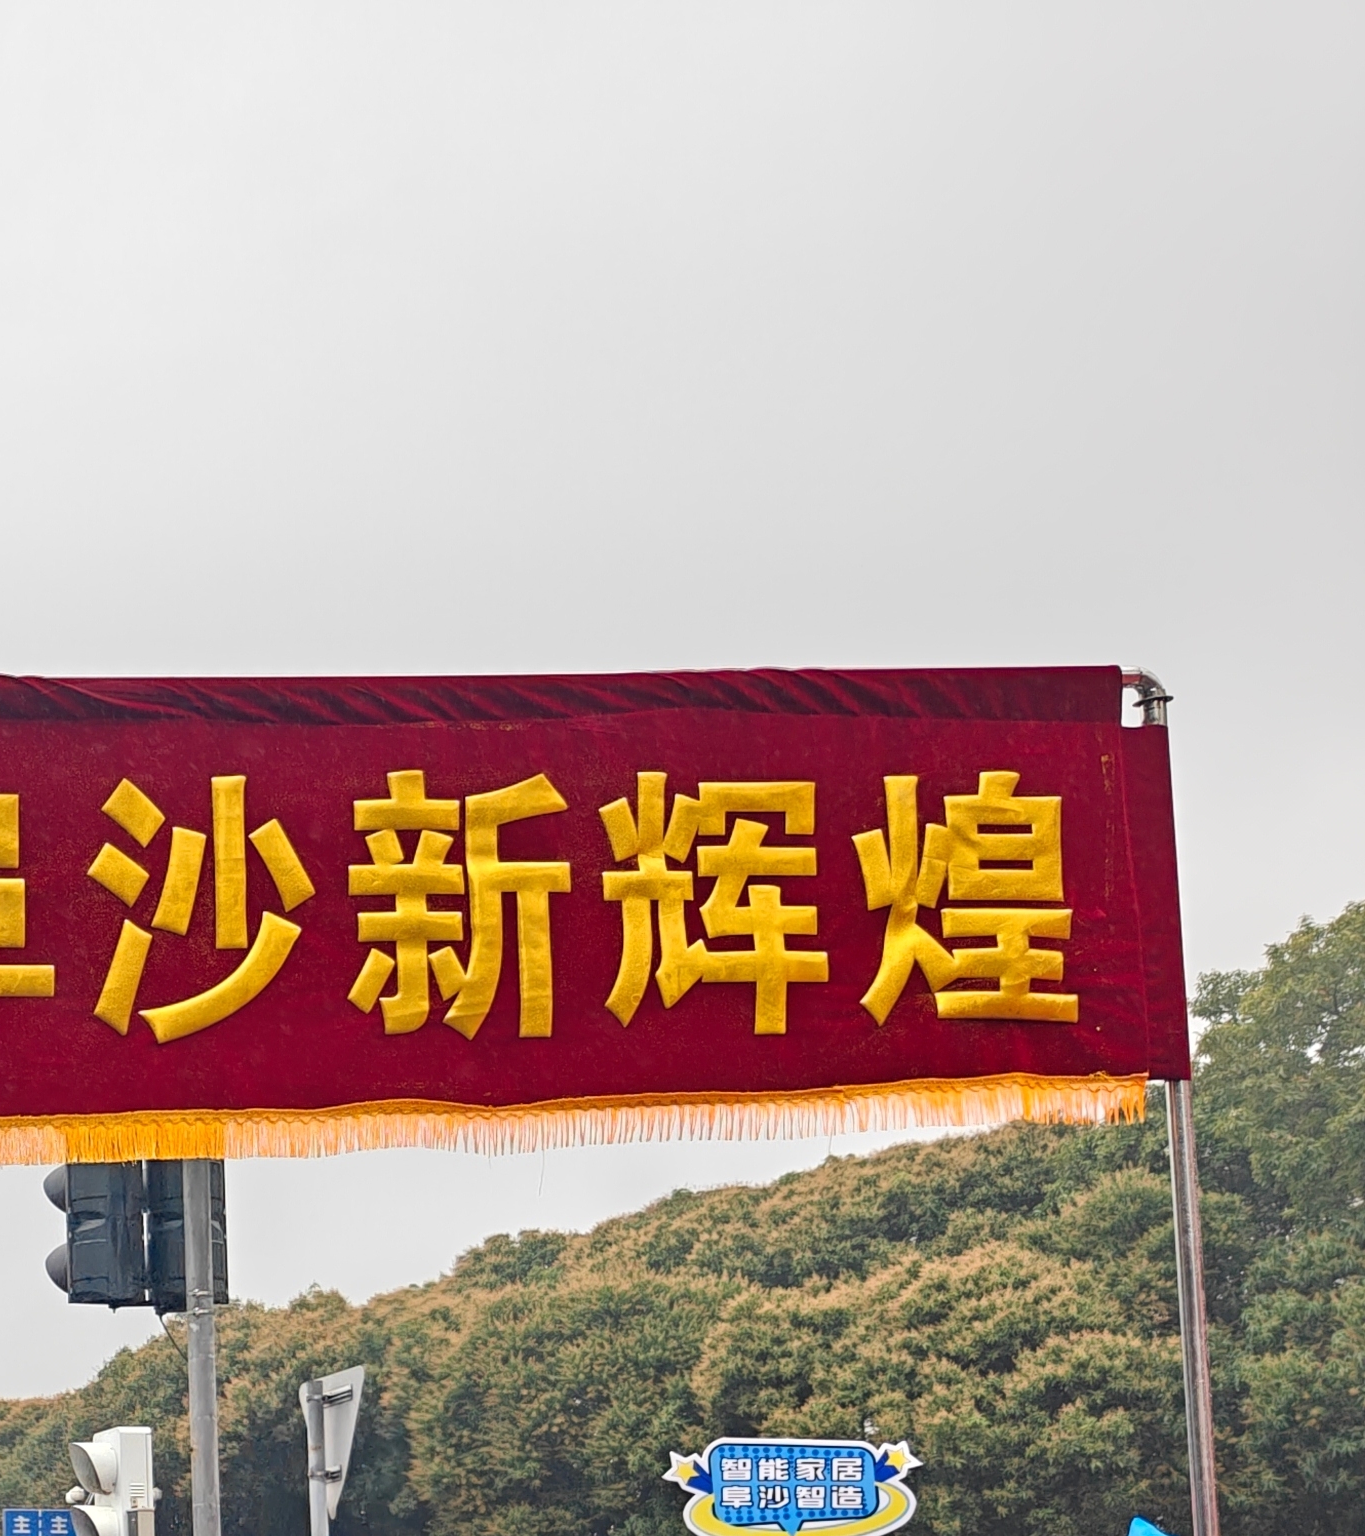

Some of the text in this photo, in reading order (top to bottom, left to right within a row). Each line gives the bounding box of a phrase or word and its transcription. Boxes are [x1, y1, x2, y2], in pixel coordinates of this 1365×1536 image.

[721, 1458, 863, 1481] 智能家居
[721, 1485, 864, 1509] 阜沙智造
